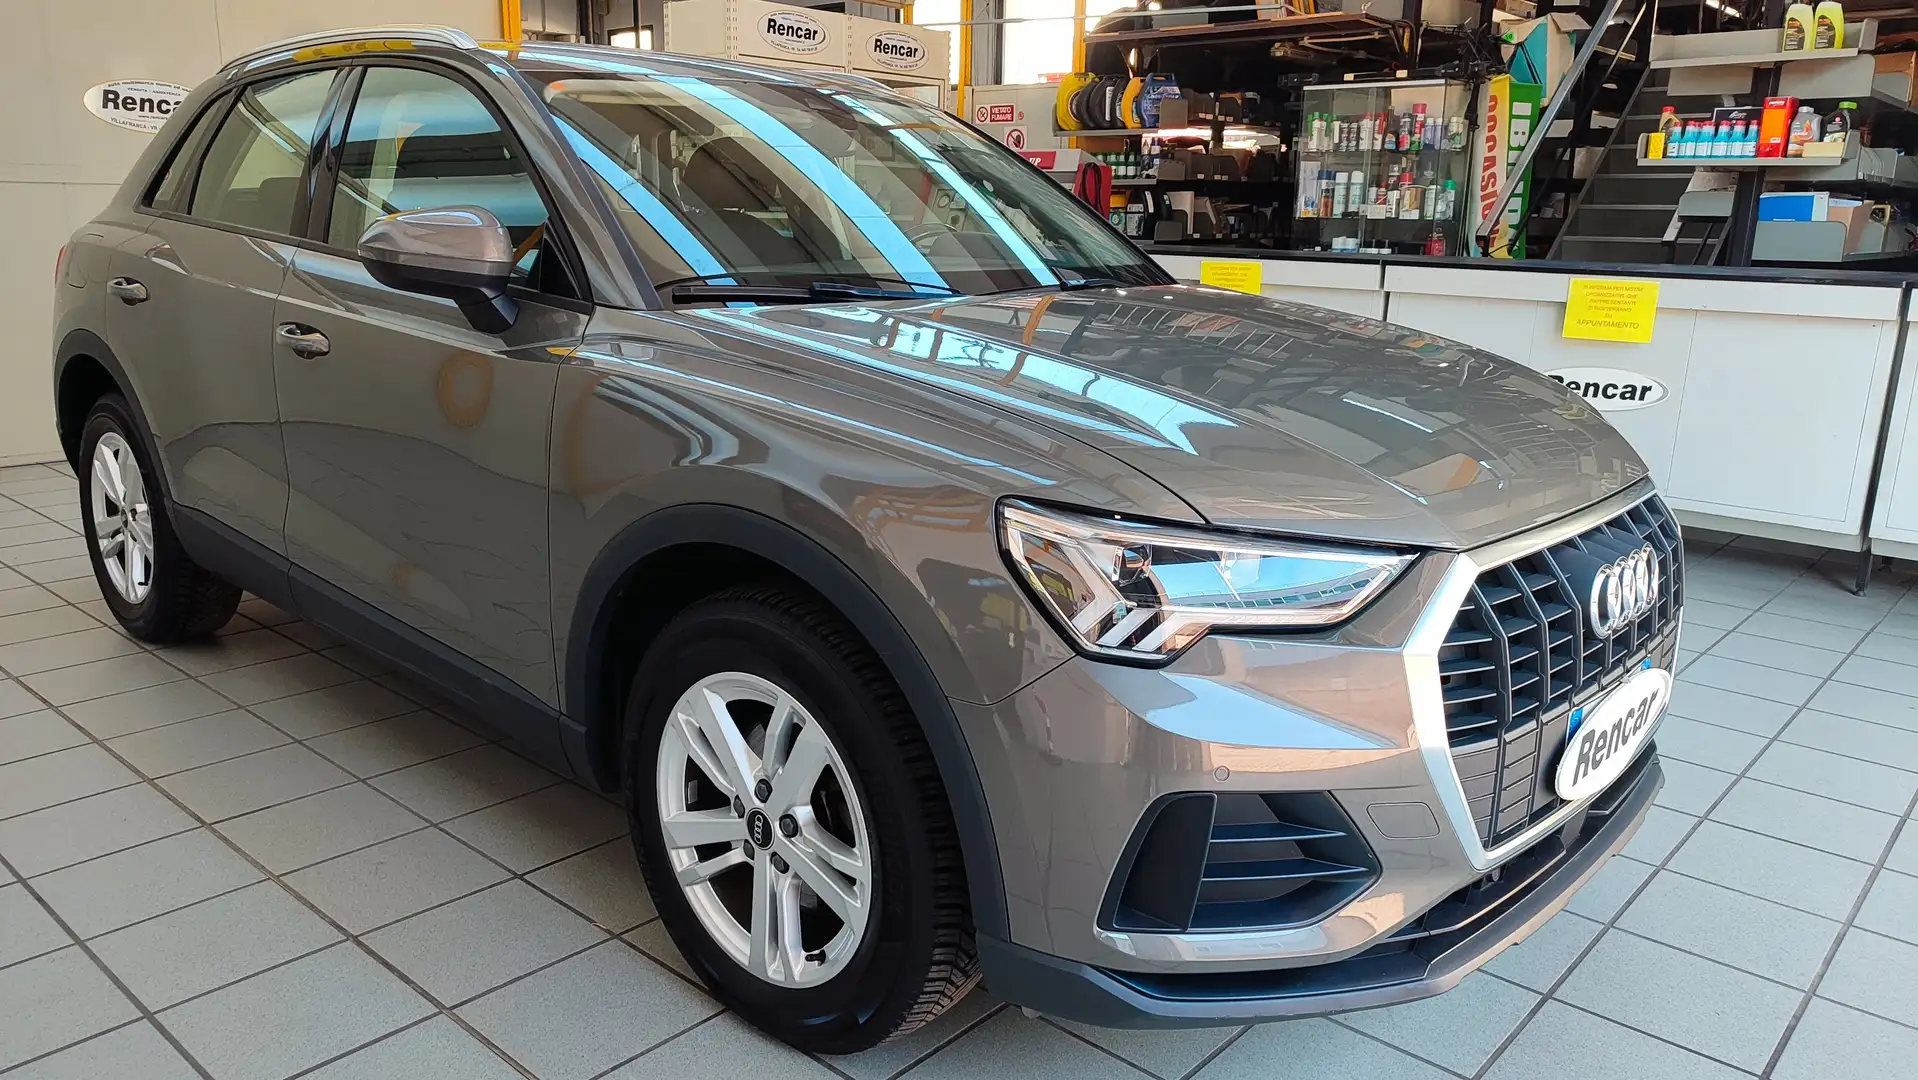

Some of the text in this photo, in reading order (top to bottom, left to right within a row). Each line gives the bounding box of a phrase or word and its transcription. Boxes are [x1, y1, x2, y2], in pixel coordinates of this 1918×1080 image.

[767, 18, 818, 41] Rencar
[874, 38, 919, 58] Rencar
[991, 106, 1012, 114] VIETATO
[991, 113, 1013, 121] FUMARE
[110, 116, 147, 130] VILLAFRANCA
[1575, 319, 1640, 330] APPUNTAMENTO
[1571, 687, 1660, 787] Rencar
